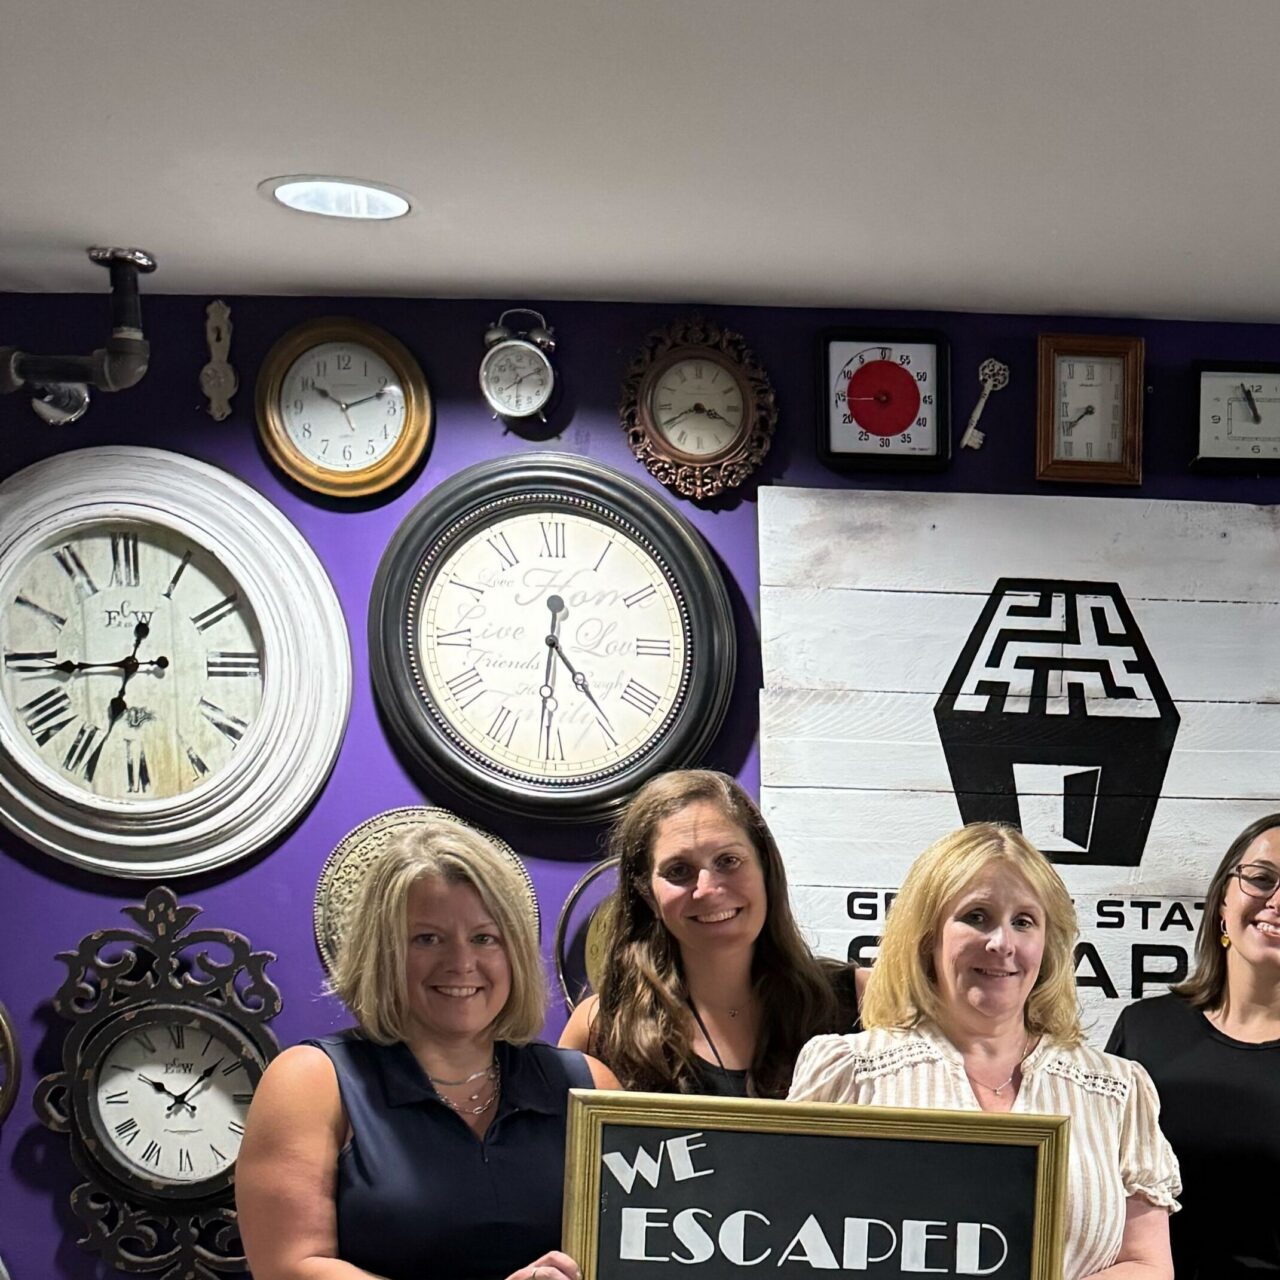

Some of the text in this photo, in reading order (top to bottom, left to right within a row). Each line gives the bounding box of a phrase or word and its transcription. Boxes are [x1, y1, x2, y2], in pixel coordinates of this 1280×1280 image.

[336, 354, 352, 370] 12
[858, 354, 865, 365] 5
[899, 354, 911, 366] 55
[316, 361, 327, 377] 11
[363, 360, 368, 377] 1
[842, 369, 853, 380] 10
[916, 372, 928, 382] 50
[1250, 385, 1263, 393] 12
[293, 399, 304, 415] 9
[386, 400, 397, 416] 3
[922, 395, 934, 405] 45
[842, 413, 854, 425] 20
[916, 417, 928, 427] 40
[301, 423, 312, 440] 8
[858, 431, 870, 442] 25
[900, 433, 912, 444] 35
[320, 439, 329, 455] 7
[365, 440, 375, 455] 5
[879, 437, 891, 448] 30
[1251, 445, 1261, 454] 6
[342, 445, 352, 461] 6
[539, 521, 566, 559] XII
[570, 617, 637, 659] Lov
[466, 648, 541, 671] Friends
[1096, 899, 1207, 932] STA
[601, 1132, 714, 1194] WE
[619, 1206, 1009, 1275] ESCAPED
